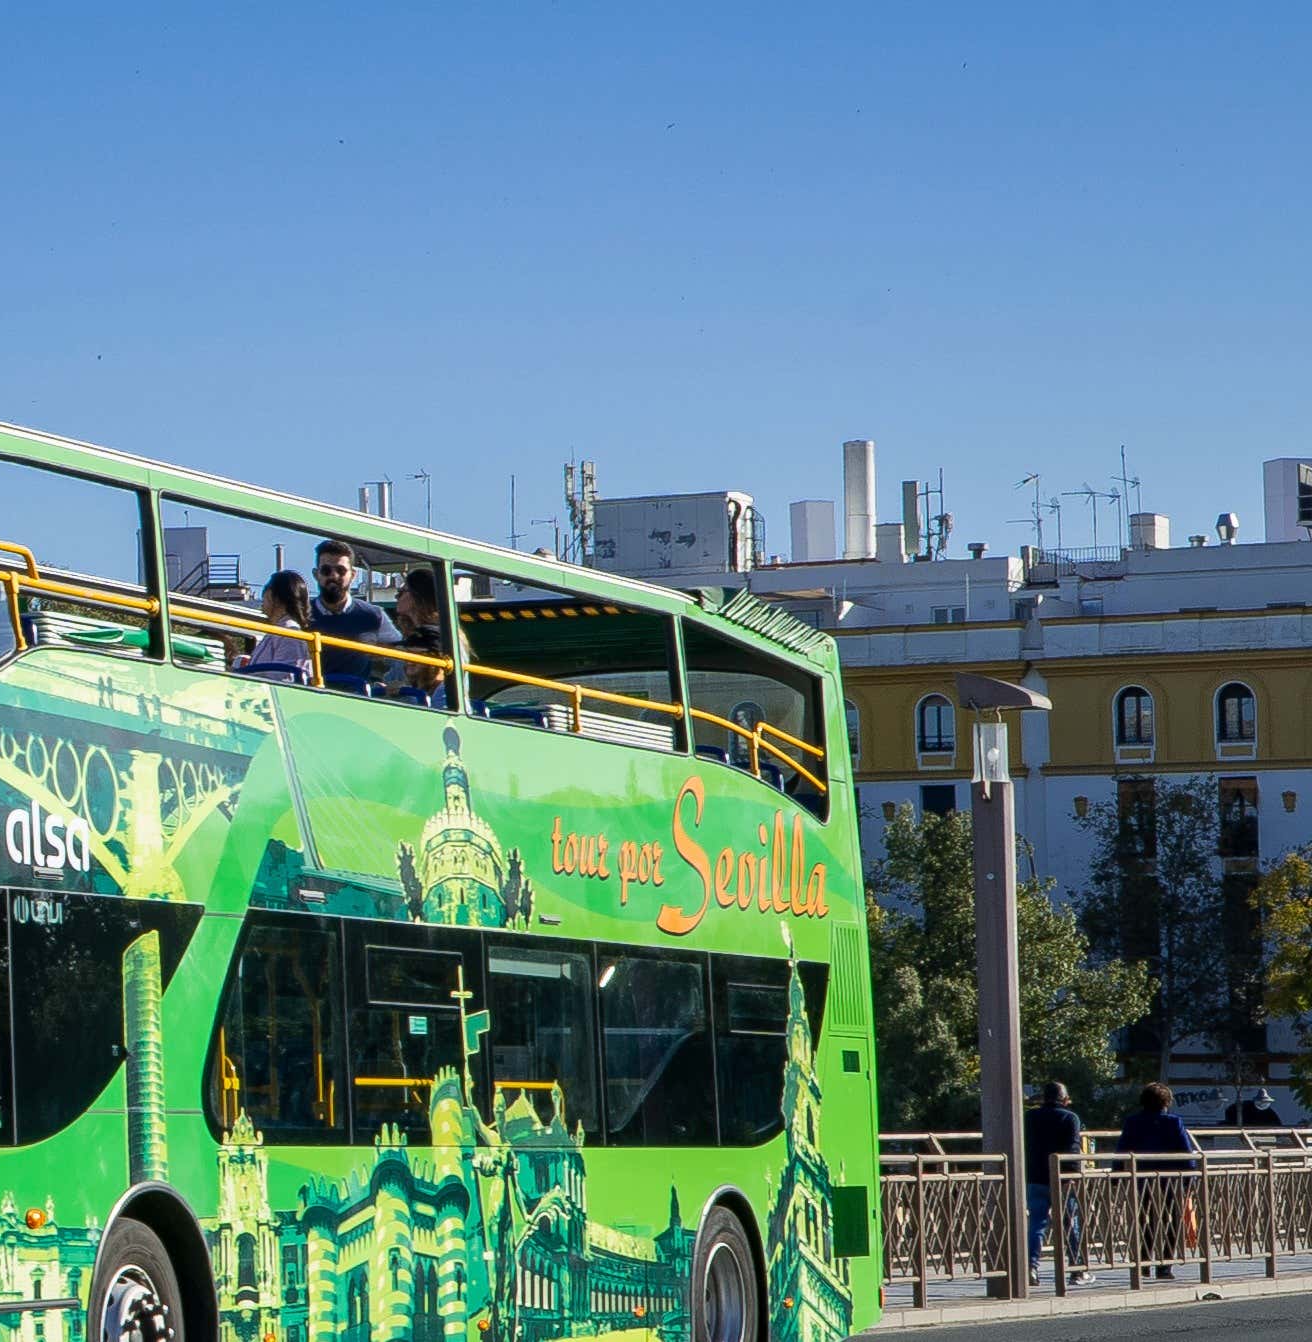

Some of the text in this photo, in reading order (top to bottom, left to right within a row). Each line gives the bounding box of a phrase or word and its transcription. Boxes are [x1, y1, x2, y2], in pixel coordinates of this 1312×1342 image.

[5, 799, 91, 872] alsa
[551, 775, 829, 936] tour por Sevilla
